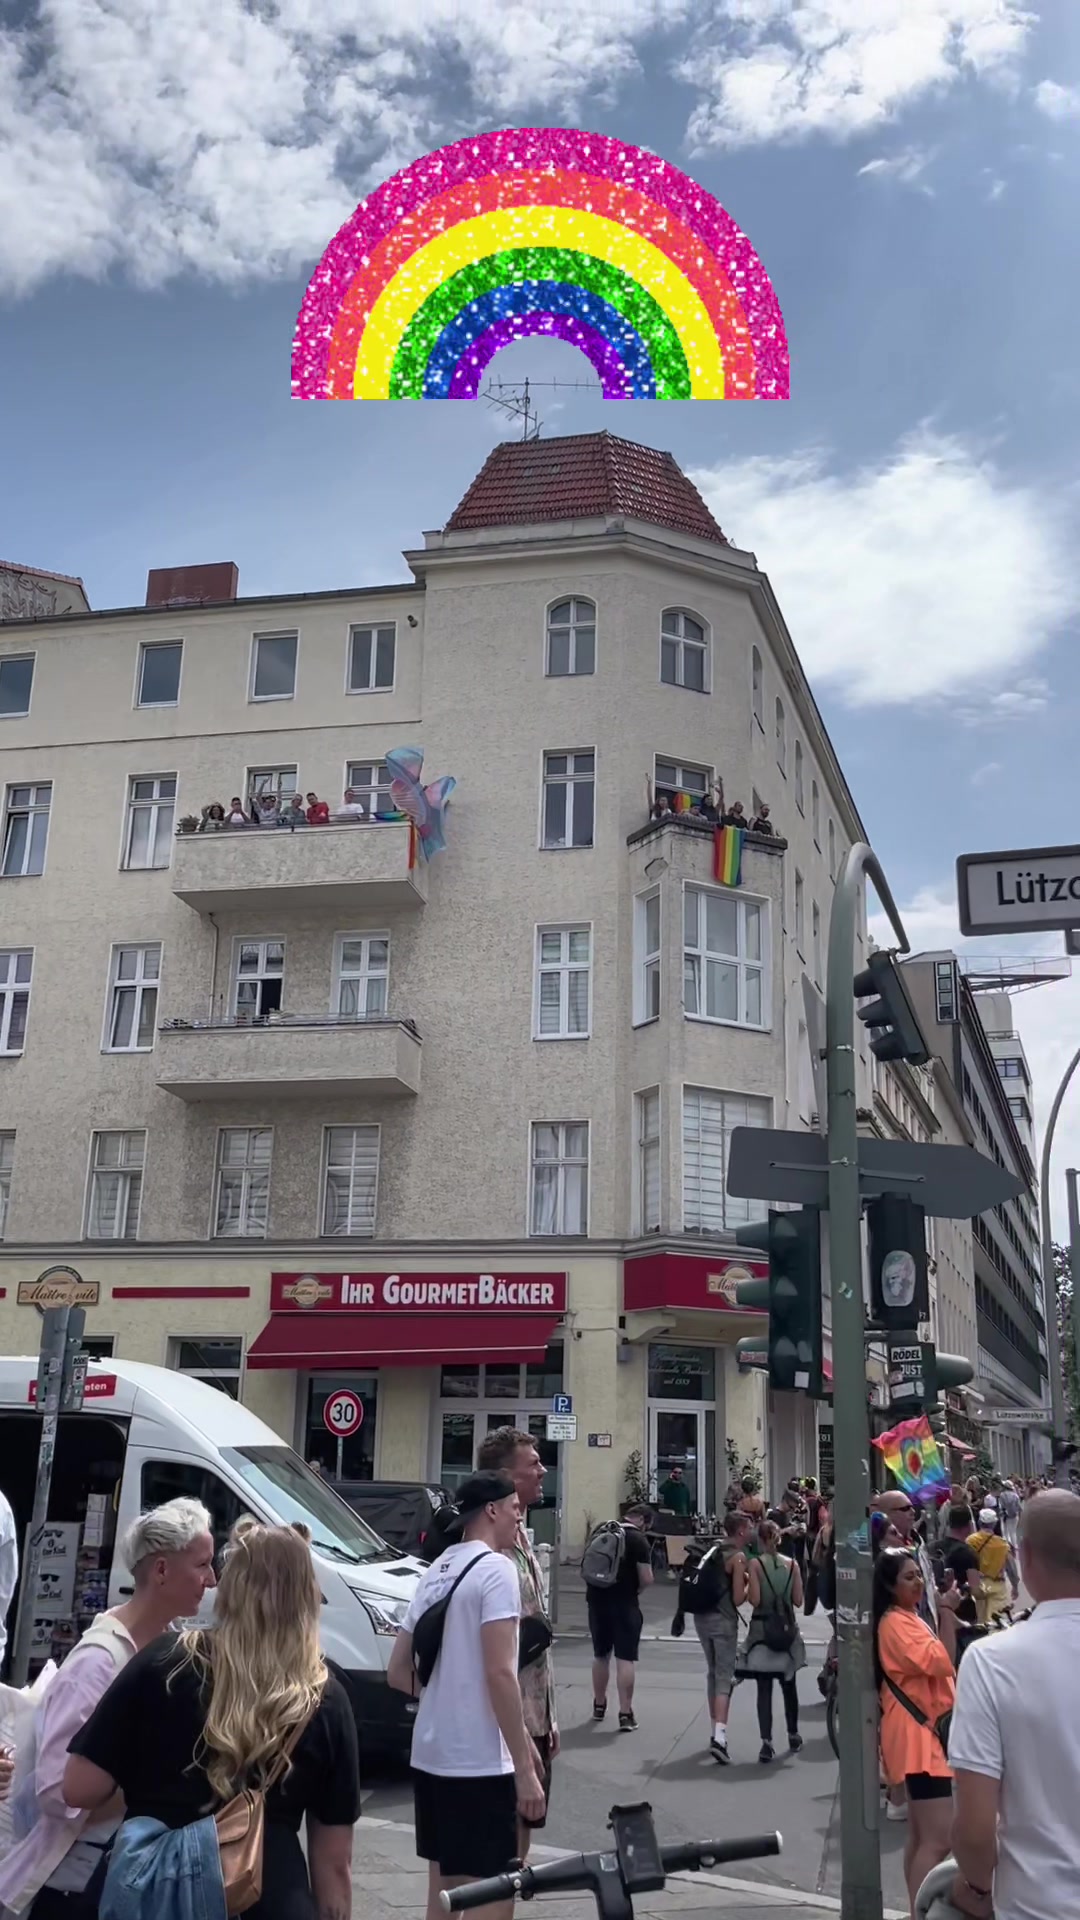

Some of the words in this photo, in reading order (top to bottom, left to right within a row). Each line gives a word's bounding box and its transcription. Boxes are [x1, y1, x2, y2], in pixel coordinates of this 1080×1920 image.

[892, 1348, 921, 1361] RÖDEL
[900, 1364, 923, 1375] JUST
[558, 1397, 569, 1412] P
[333, 1403, 354, 1422] 30
